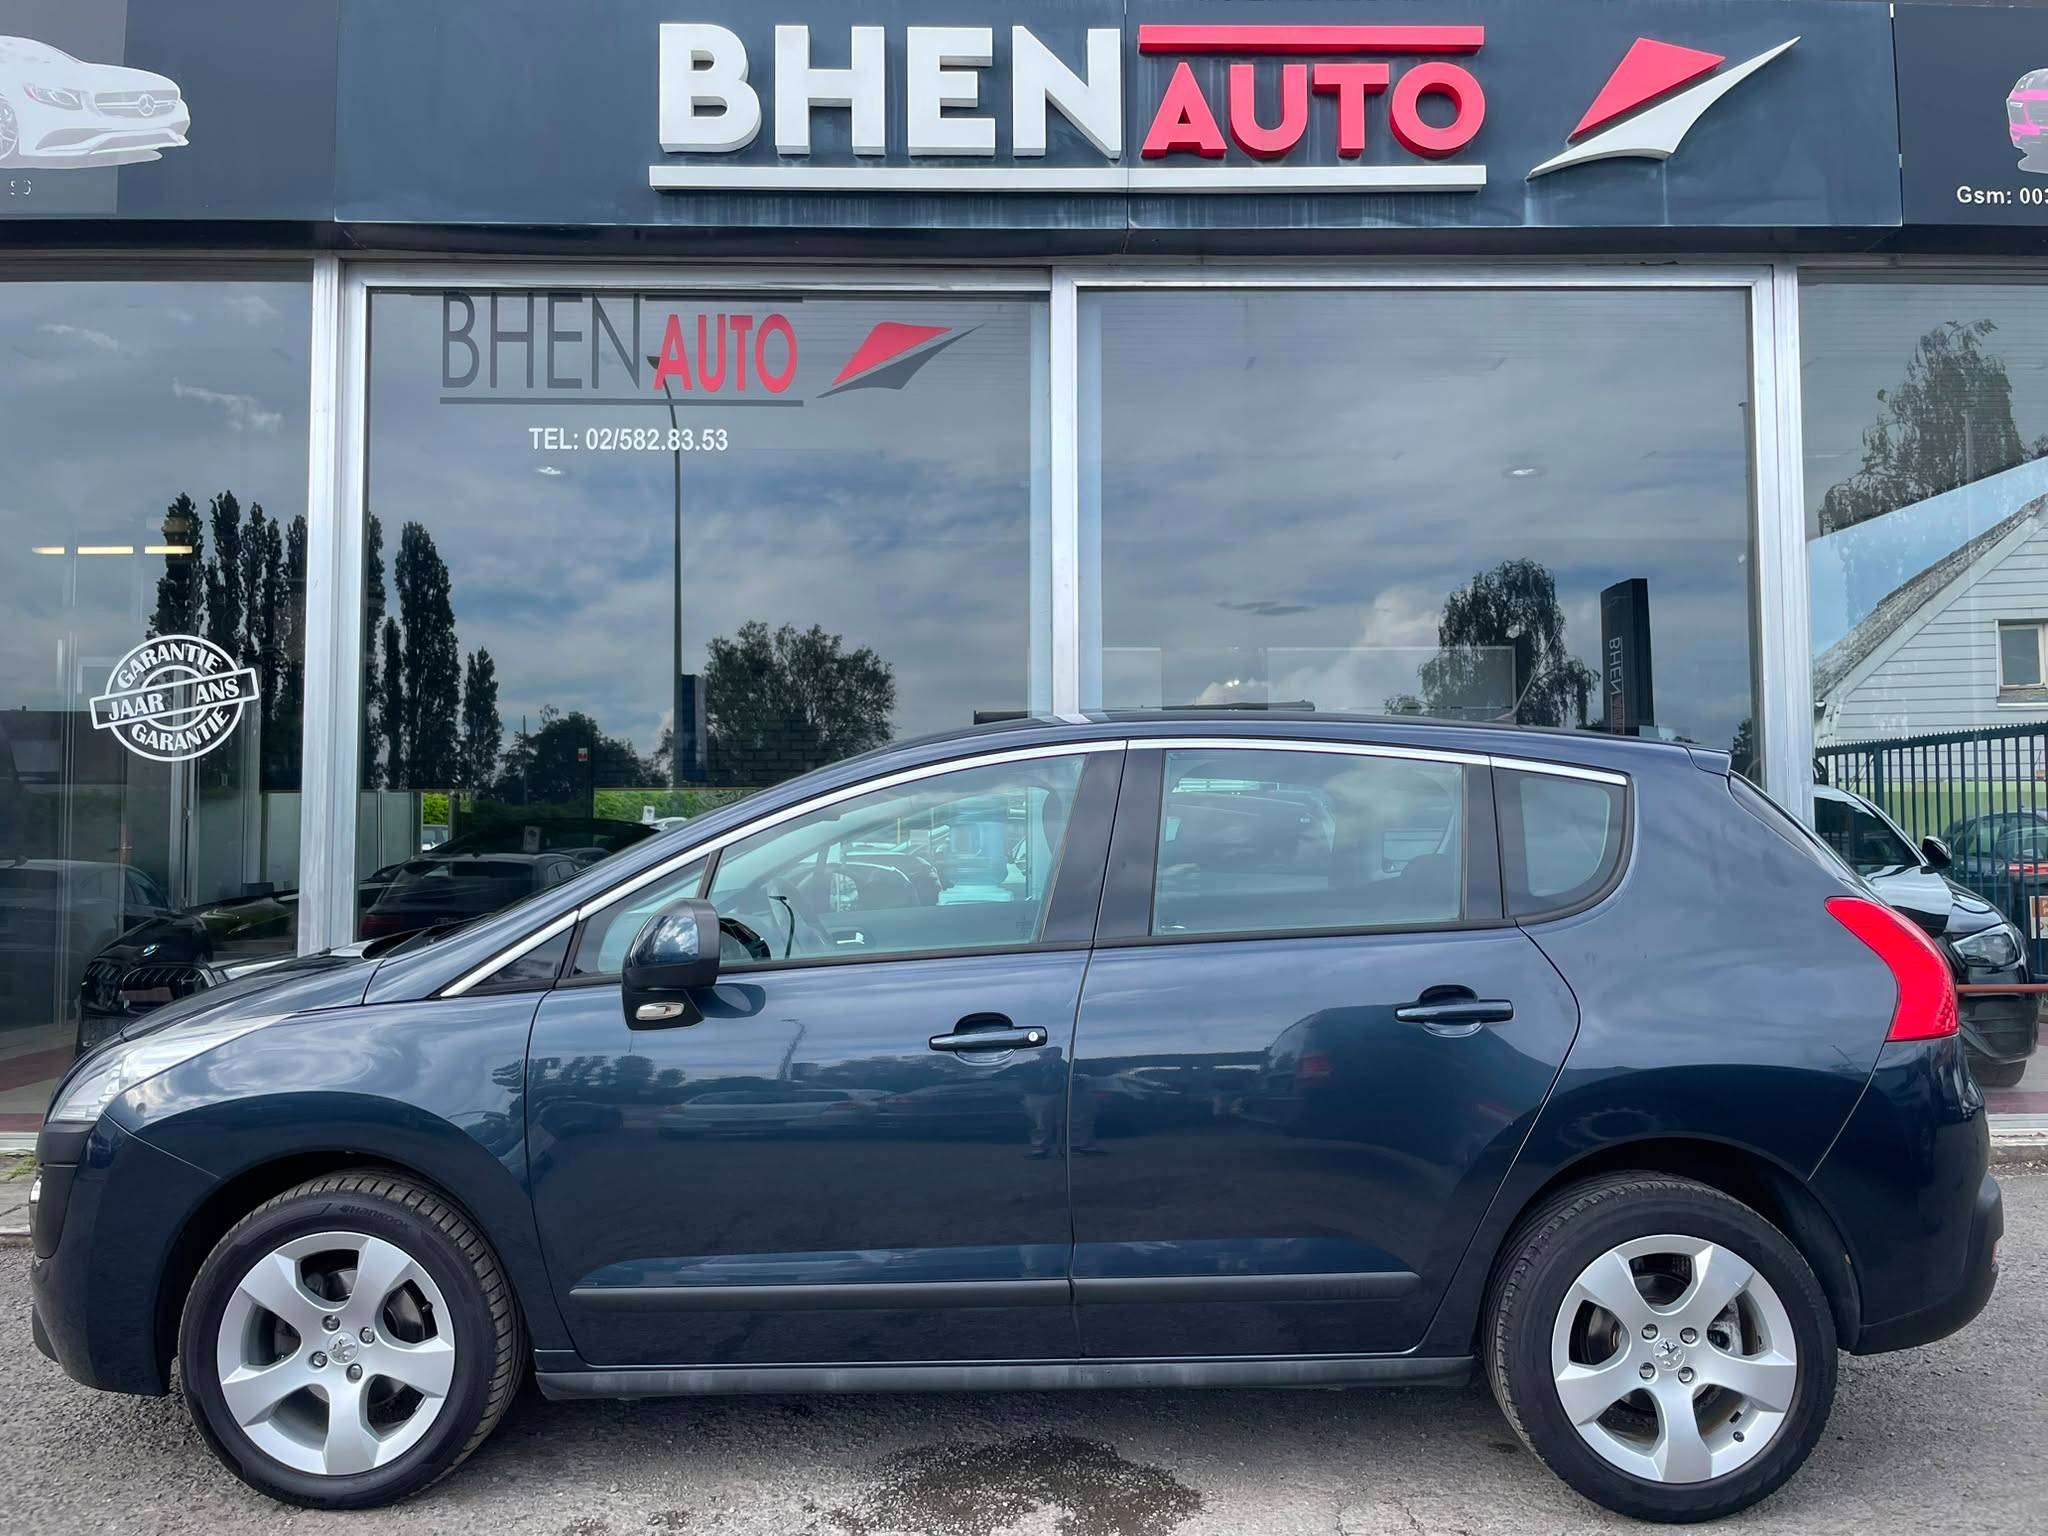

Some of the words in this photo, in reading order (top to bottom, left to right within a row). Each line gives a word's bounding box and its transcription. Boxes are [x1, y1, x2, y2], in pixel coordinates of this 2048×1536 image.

[658, 22, 1122, 160] BHEN
[1140, 60, 1486, 160] AUTO
[1956, 185, 2012, 205] Gsm:
[442, 290, 641, 390] BHEN
[652, 313, 798, 394] AUTO
[528, 427, 579, 451] TEL:
[585, 427, 729, 452] 02/582.83.53
[117, 643, 223, 689] GARANTIE
[108, 692, 166, 721] JAAR
[196, 678, 240, 705] ANS
[131, 705, 231, 751] GARANTIE
